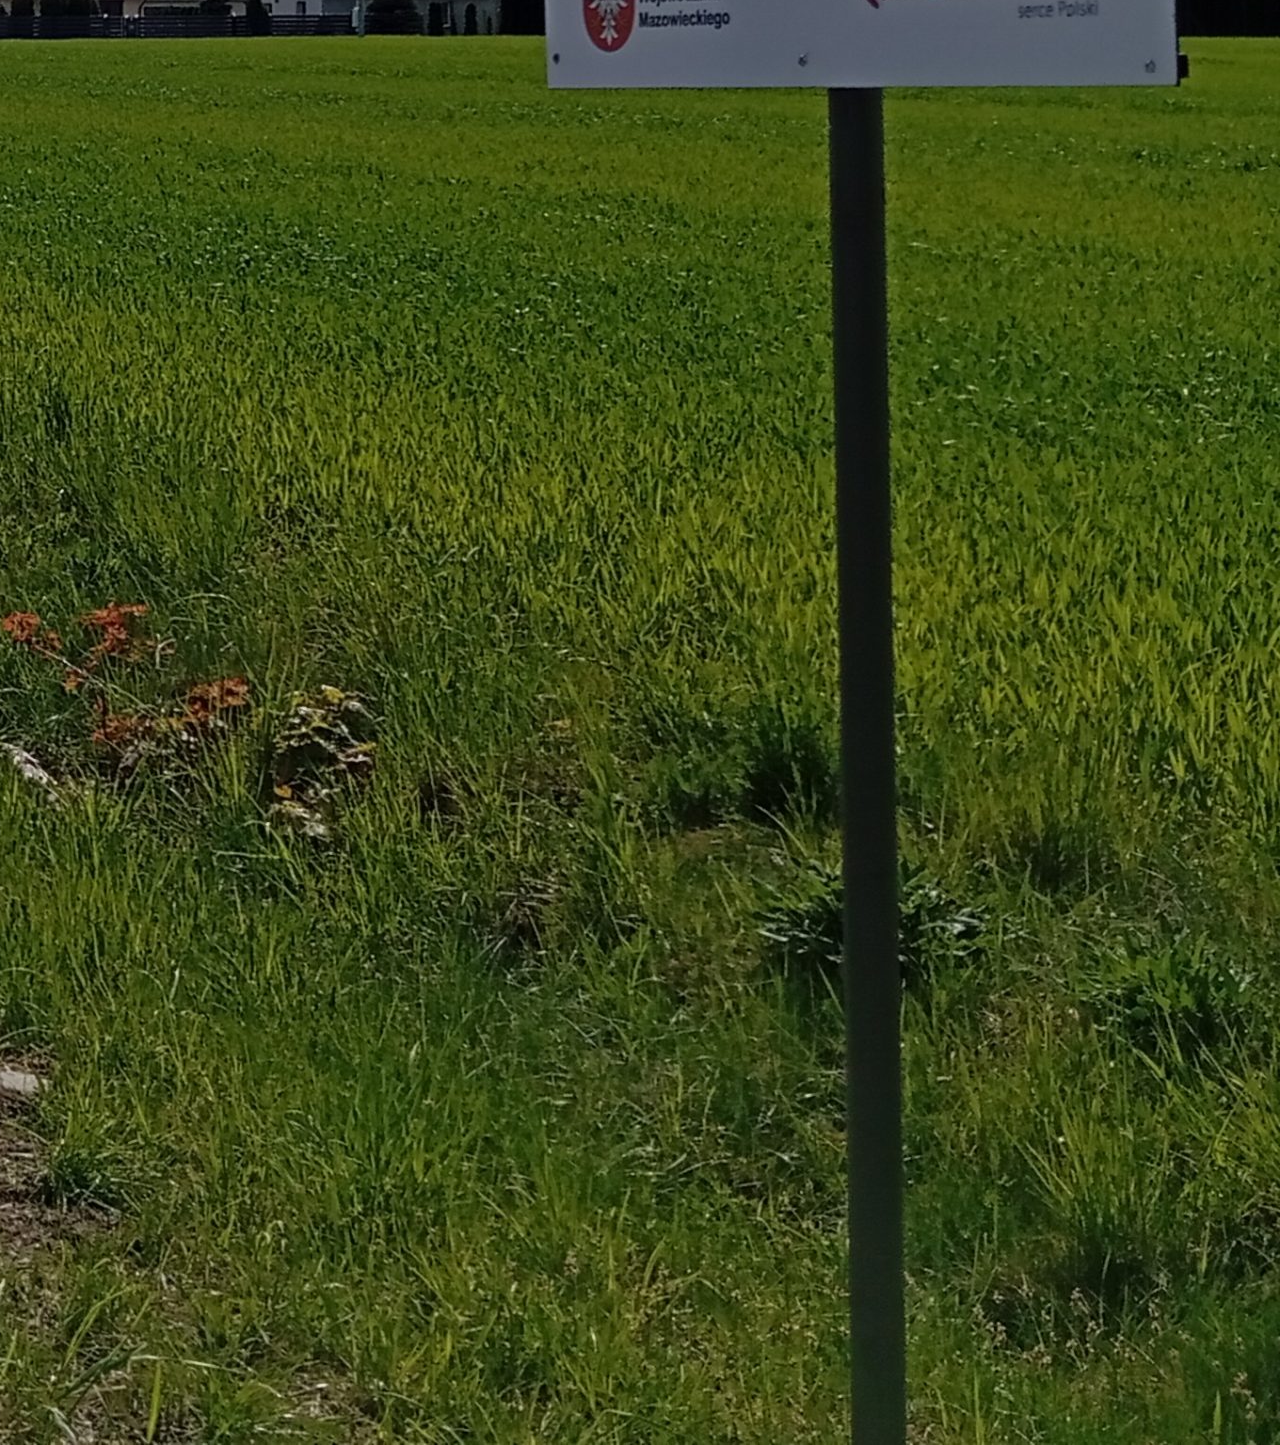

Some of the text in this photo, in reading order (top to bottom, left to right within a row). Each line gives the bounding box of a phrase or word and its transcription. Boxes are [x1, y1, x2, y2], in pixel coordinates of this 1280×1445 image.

[1017, 0, 1099, 18] serce Polski
[638, 9, 730, 30] Mazowieckiego
